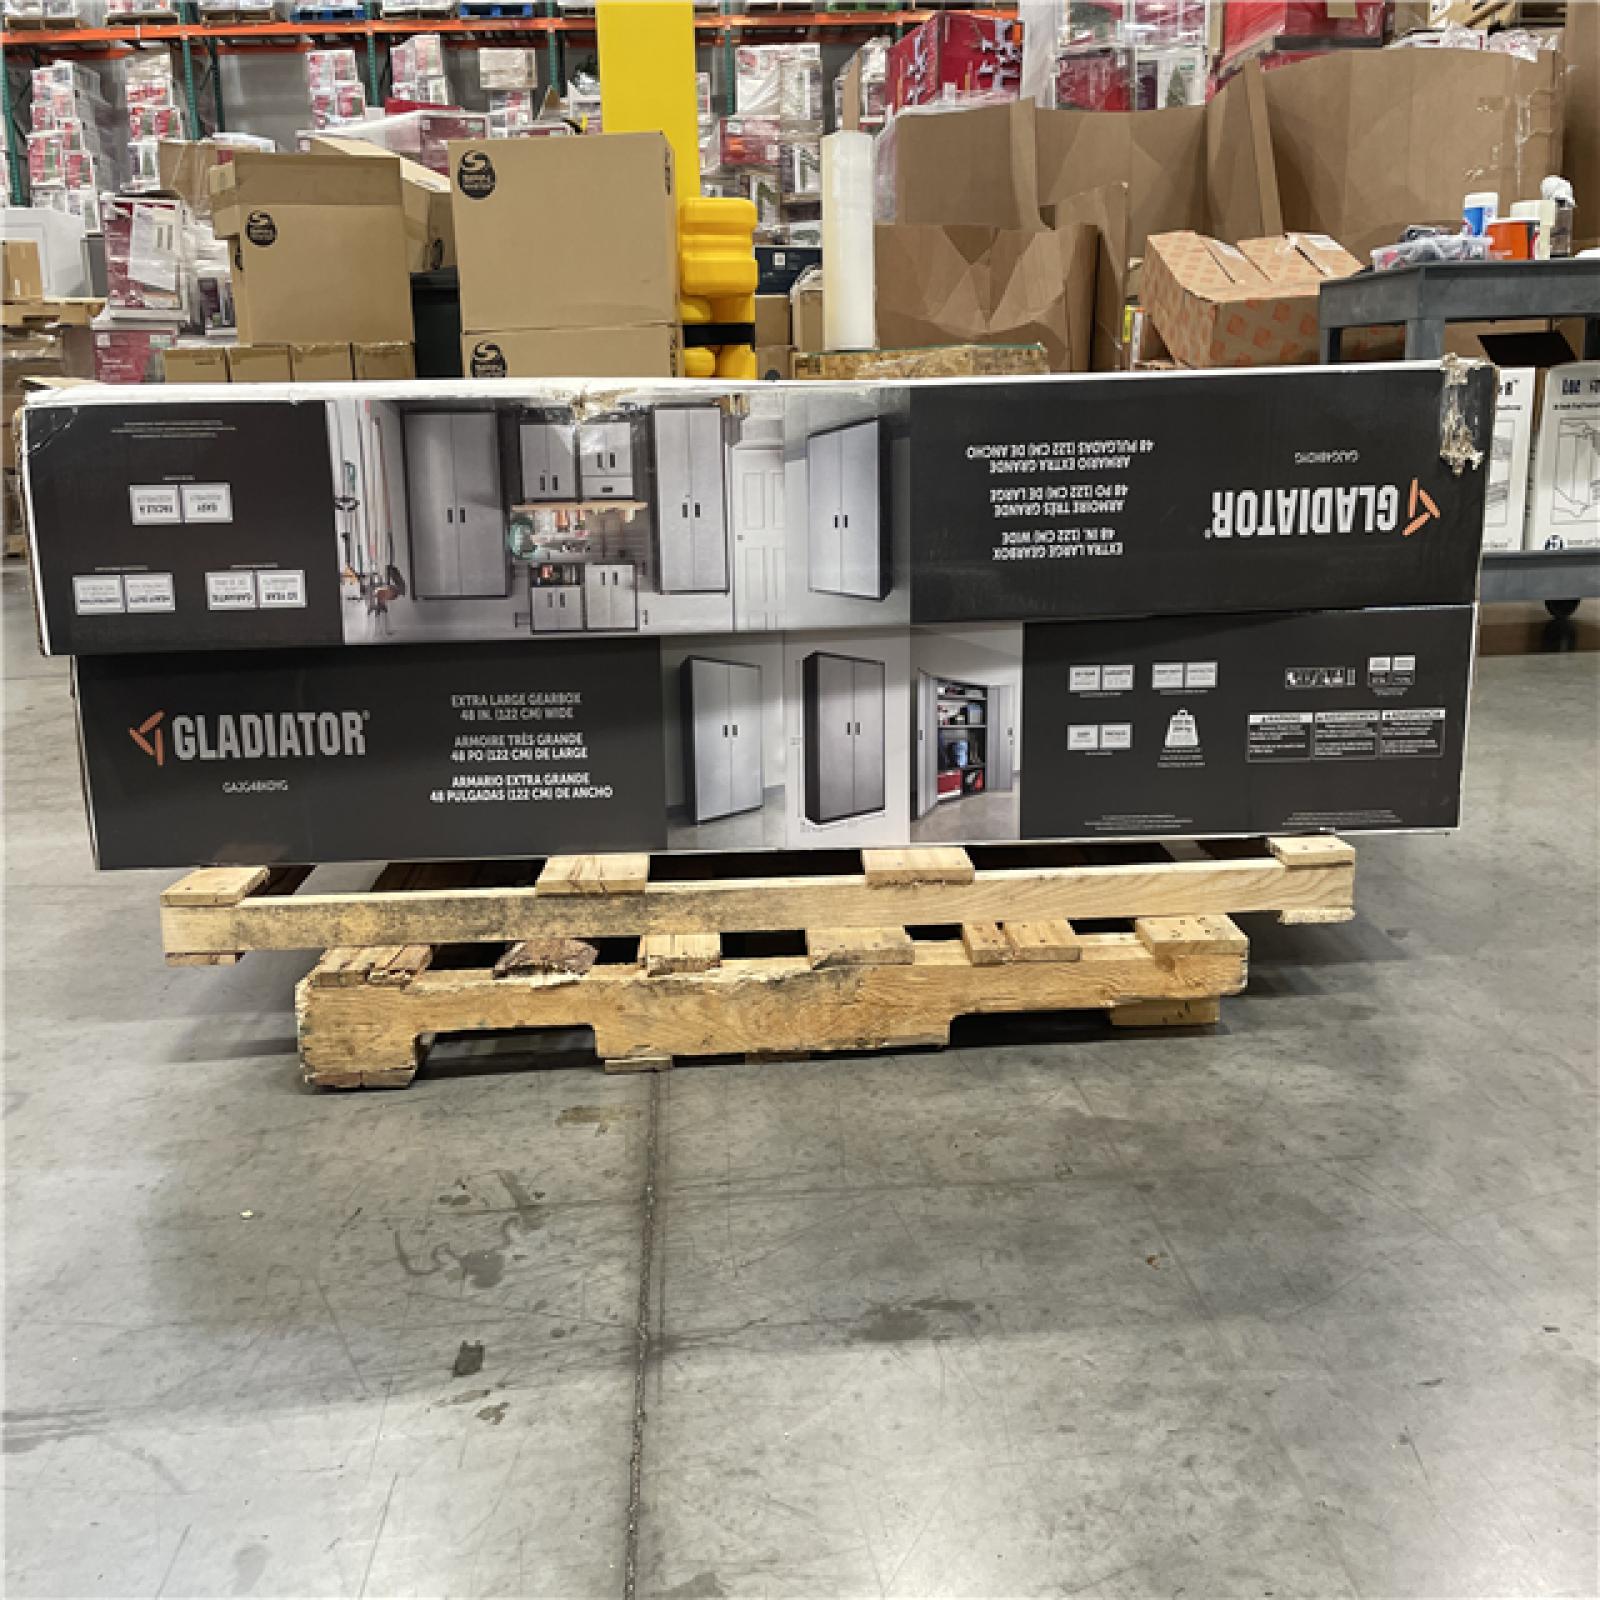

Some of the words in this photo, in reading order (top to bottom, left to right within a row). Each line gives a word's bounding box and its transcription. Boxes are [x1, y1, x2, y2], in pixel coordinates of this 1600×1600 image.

[967, 444, 1008, 458] ANCHO
[1011, 444, 1025, 456] DE
[1079, 440, 1137, 454] PULGADAS
[1140, 440, 1154, 451] 48
[990, 459, 1037, 473] GRANDE
[1040, 457, 1075, 470] EXTRA
[1078, 456, 1130, 469] ARMARIO
[990, 488, 1025, 503] LARGE
[1030, 487, 1043, 500] DE
[1095, 485, 1110, 496] PO
[1114, 485, 1128, 496] 48
[995, 503, 1040, 518] GRANDE
[1073, 500, 1124, 513] ARMOIRE
[1002, 531, 1030, 545] WIDE
[1100, 528, 1115, 540] 48
[992, 546, 1045, 560] GEARBOX
[1049, 544, 1084, 558] LARGE
[1087, 542, 1123, 555] EXTRA
[451, 694, 487, 707] EXTRA
[490, 694, 525, 705] LARGE
[528, 692, 581, 705] GEARBOX
[461, 710, 475, 720] 48
[545, 708, 573, 718] WIDE
[455, 735, 505, 746] ARMOIRE
[536, 733, 583, 745] GRANDE
[451, 749, 465, 760] 48
[468, 749, 483, 760] PO
[535, 748, 550, 760] DE
[552, 747, 588, 759] LARGE
[452, 775, 503, 787] ARMARIO
[506, 774, 542, 785] EXTRA
[545, 772, 589, 785] GRANDE
[430, 790, 445, 802] 48
[447, 790, 505, 801] PULGADAS
[555, 787, 570, 798] DE
[572, 785, 613, 798] ANCHO
